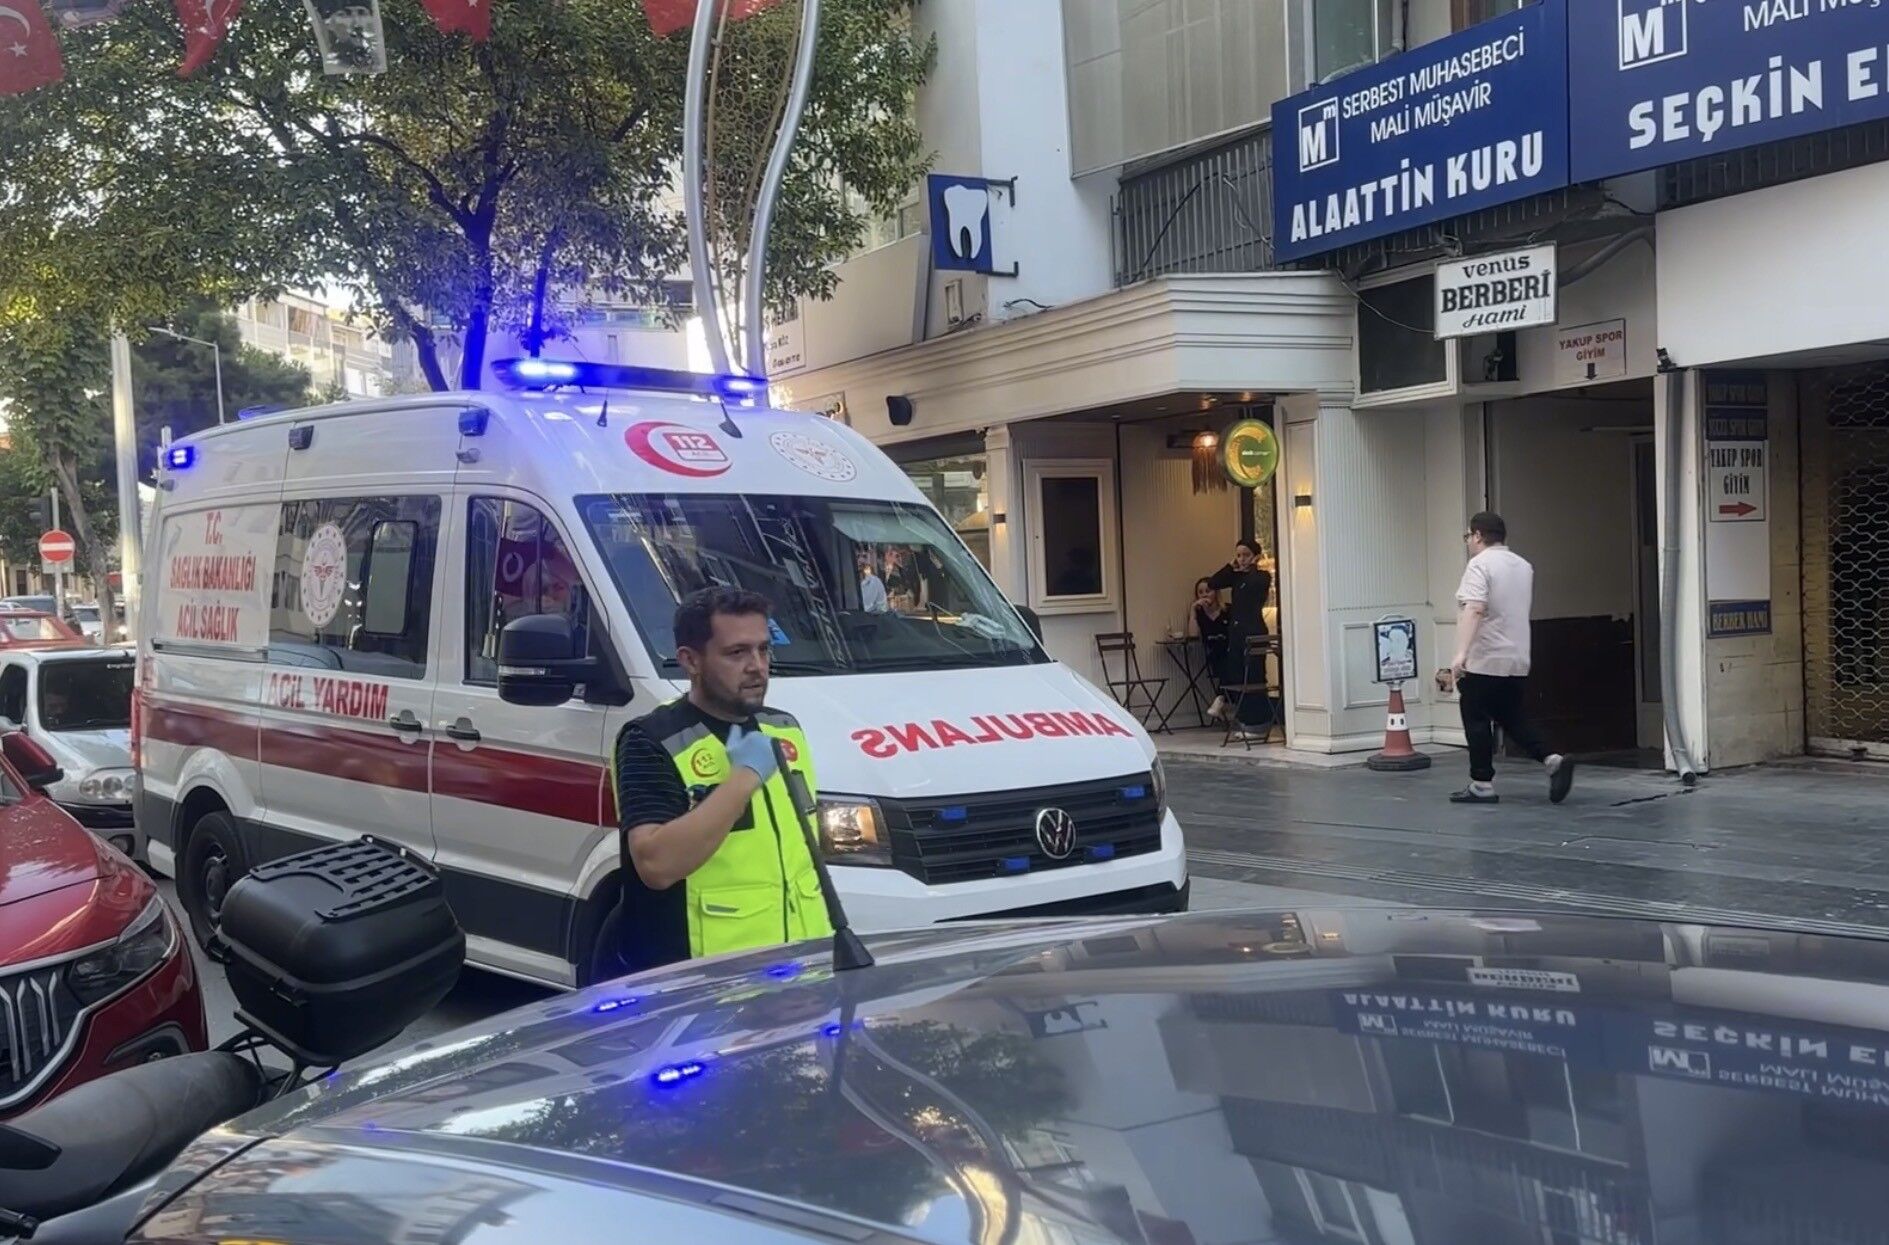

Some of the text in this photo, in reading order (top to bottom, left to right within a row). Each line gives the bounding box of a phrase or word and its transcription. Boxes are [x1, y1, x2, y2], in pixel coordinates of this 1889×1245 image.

[1342, 26, 1524, 119] SERBEST MUHASEBECİ
[1628, 44, 1889, 150] SEÇKİN E
[1371, 79, 1492, 144] MALİ MÜŞAVİR
[1290, 130, 1543, 243] ALAATTİN KURU
[1440, 269, 1552, 314] BERBERİ
[1558, 330, 1622, 350] YAKUP SPOR
[671, 435, 712, 449] 112
[313, 675, 390, 721] YARDIM
